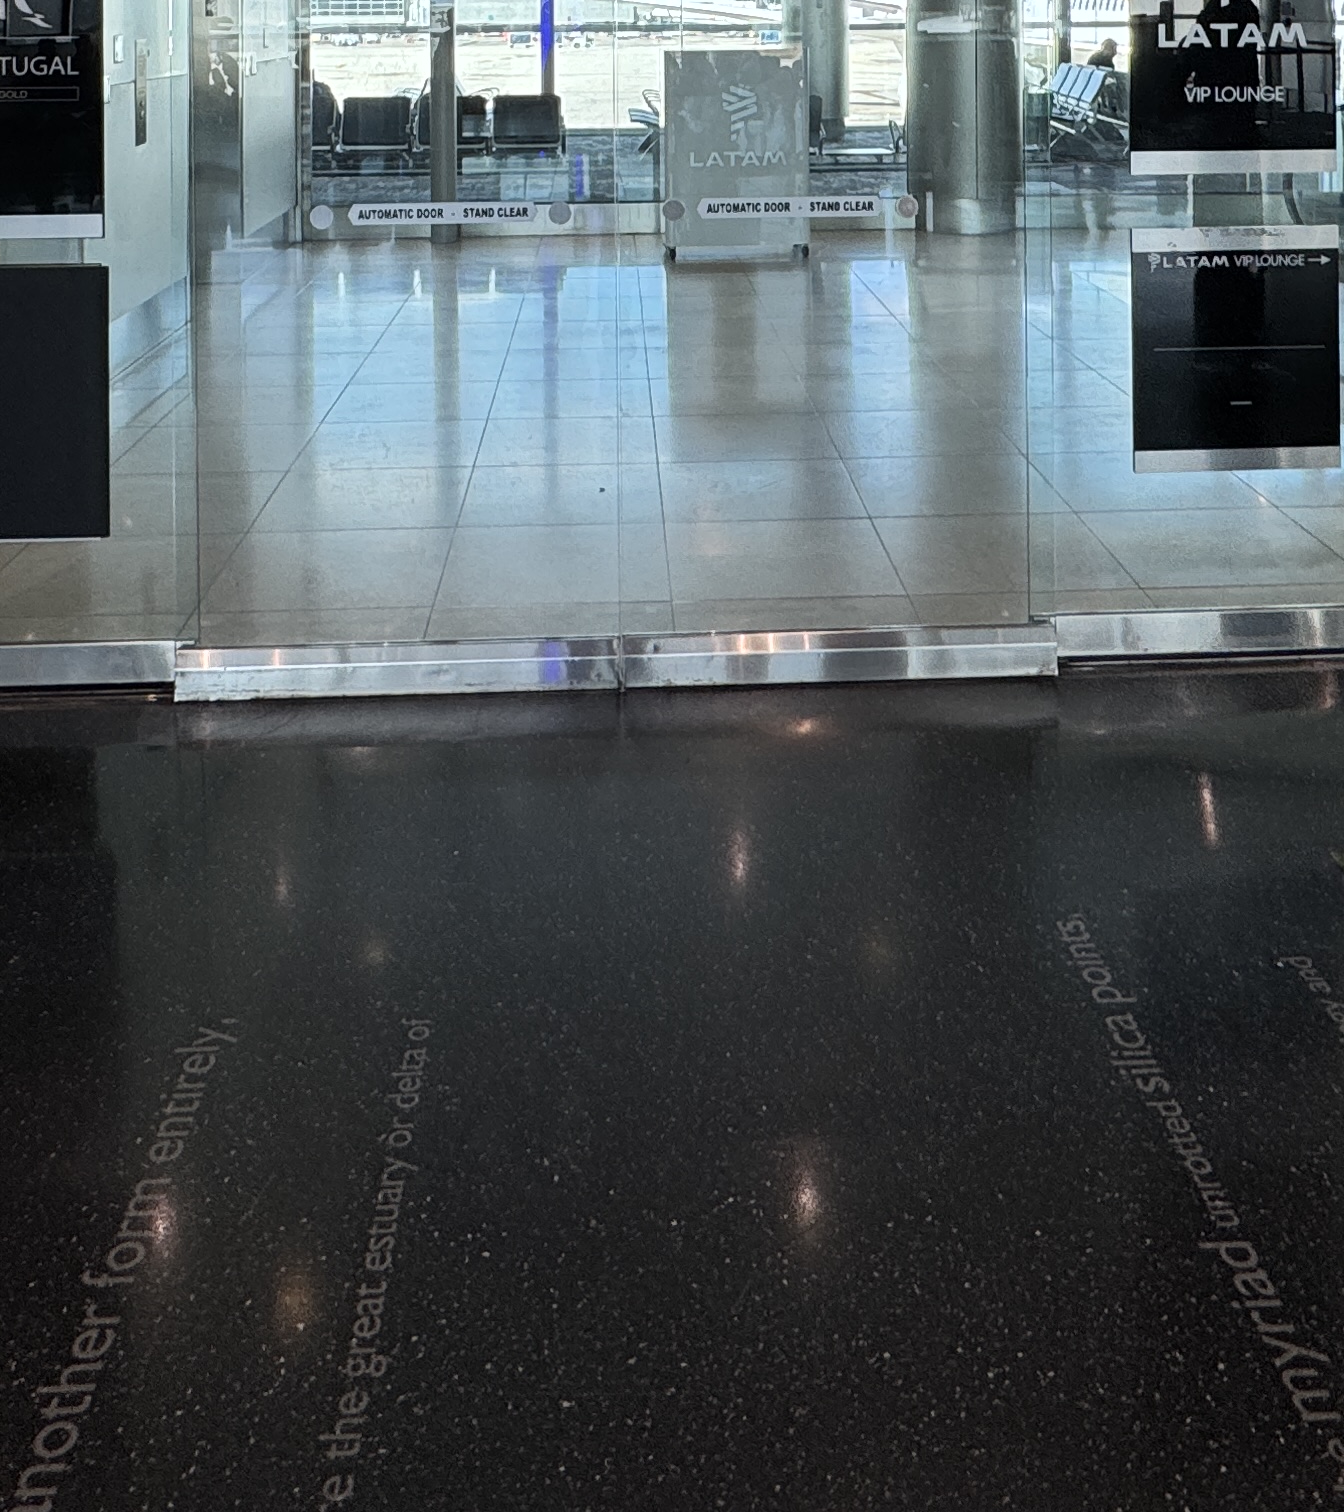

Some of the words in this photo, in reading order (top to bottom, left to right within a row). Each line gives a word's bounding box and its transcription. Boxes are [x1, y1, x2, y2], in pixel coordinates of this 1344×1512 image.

[1157, 22, 1308, 48] LATAM
[1184, 86, 1211, 103] VIP
[1215, 86, 1285, 103] LOUNGE
[689, 151, 787, 168] LATAM
[358, 208, 414, 220] AUTOMATIC
[417, 208, 444, 219] DOOR
[462, 207, 495, 219] STAND
[497, 207, 529, 218] CLEAR
[706, 202, 761, 214] AUTOMATIC
[764, 202, 791, 213] DOOR
[843, 201, 874, 211] CLEAR
[1162, 255, 1229, 268] LATAM
[1233, 254, 1253, 267] VIP
[1255, 253, 1305, 266] LOUNGE
[1278, 953, 1331, 998] and
[401, 1017, 433, 1041] of
[1105, 1012, 1171, 1095] silica
[388, 1046, 428, 1110] delta
[379, 1118, 413, 1148] or
[1147, 1096, 1240, 1230] unrotted
[81, 1177, 174, 1288] form
[364, 1158, 419, 1273] estuary
[347, 1280, 389, 1379] great
[1198, 1239, 1342, 1424] myriad
[318, 1388, 370, 1460] the
